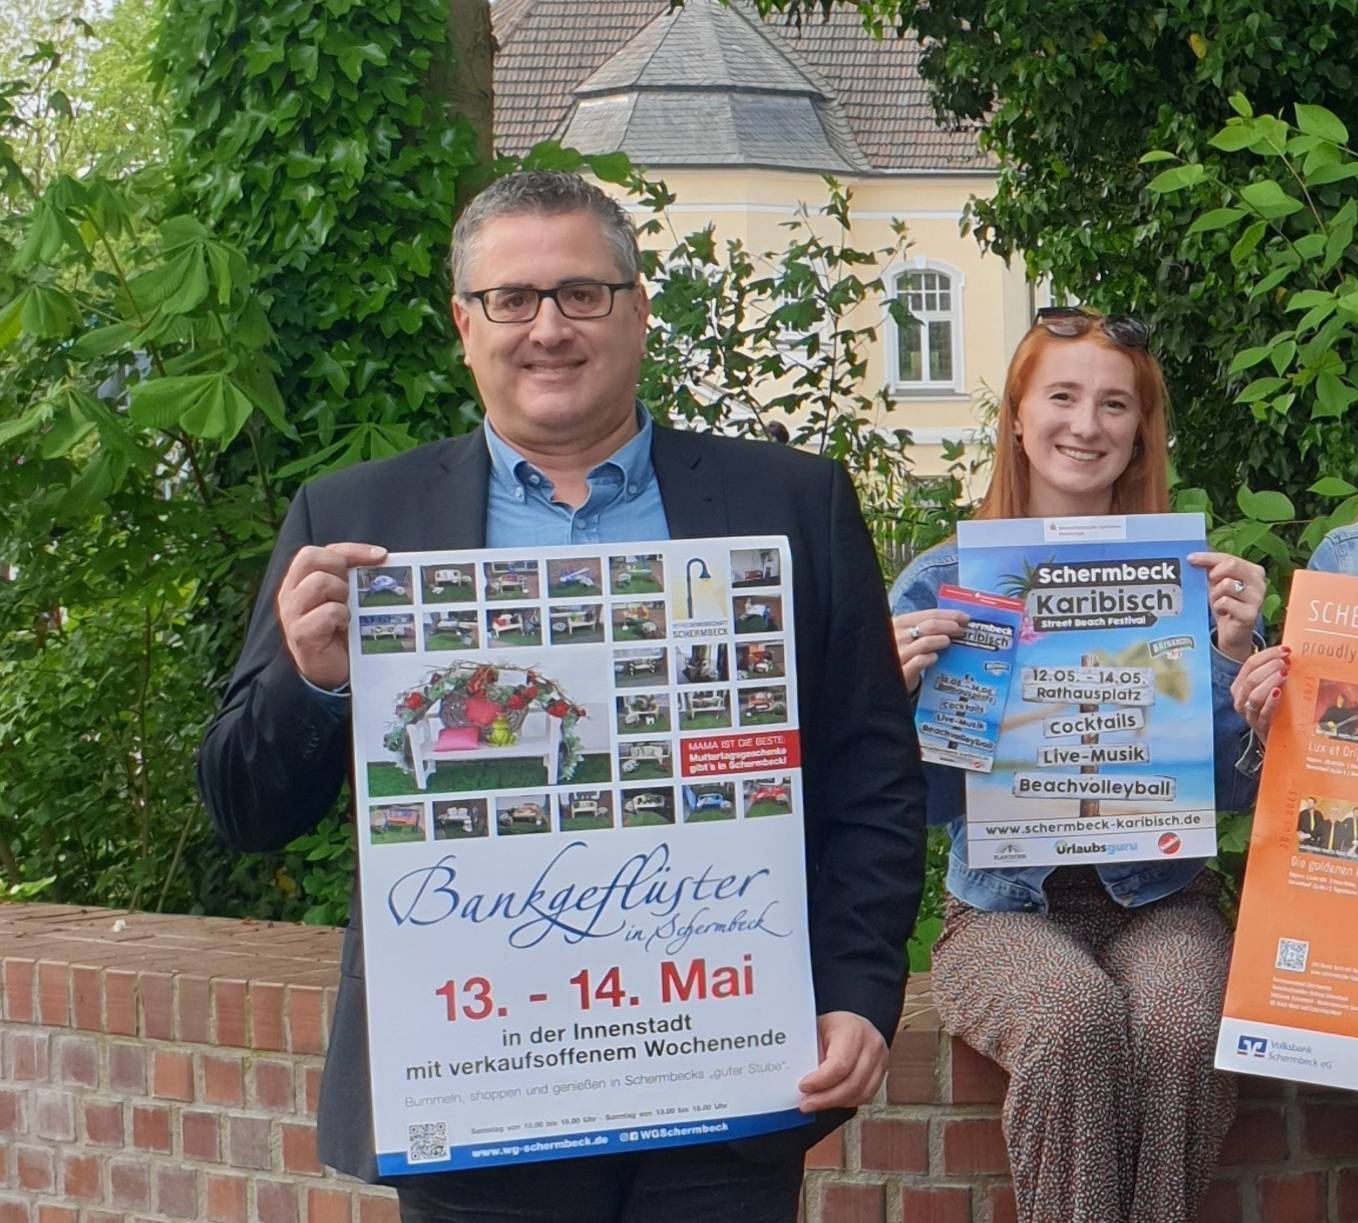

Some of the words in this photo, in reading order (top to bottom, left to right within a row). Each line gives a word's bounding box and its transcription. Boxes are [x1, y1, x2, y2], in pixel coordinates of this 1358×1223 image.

[1038, 562, 1176, 584] Schermbeck
[1037, 588, 1174, 615] Karibisch
[1041, 618, 1072, 628] Street
[1075, 617, 1105, 627] Beach
[1108, 615, 1146, 626] Festival
[673, 628, 728, 639] SCHERMBECK
[1301, 641, 1357, 664] proudly
[1033, 669, 1080, 683] 12.05.
[1099, 671, 1146, 685] 14.05.
[1037, 687, 1141, 702] Rathausplatz
[1050, 712, 1137, 735] Cocktails
[688, 740, 718, 750] MAMA
[721, 739, 735, 748] IST
[738, 737, 753, 747] DIE
[1308, 742, 1327, 753] Lux
[1043, 745, 1145, 764] Live-Musik
[1020, 778, 1170, 799] Beachvolleyball
[985, 814, 1201, 835] www.schermbeck-karibisch.de
[1290, 855, 1306, 869] Die
[388, 841, 770, 948] Bankgeflüster
[624, 922, 645, 942] in
[645, 901, 793, 955] Schermbeck
[435, 976, 508, 1021] 13.
[529, 992, 547, 1003] -
[569, 966, 640, 1011] 14.
[661, 954, 754, 1003] Mai
[502, 1028, 521, 1047] in
[530, 1024, 566, 1046] der
[573, 1014, 692, 1041] Innenstadt
[405, 1060, 443, 1081] mit
[449, 1043, 637, 1077] verkaufsoffenem
[644, 1029, 787, 1059] Wochenende
[1270, 1040, 1312, 1053] Volksbank
[1267, 1051, 1318, 1067] Schermbeck
[404, 1093, 465, 1109] Bummeln,
[470, 1086, 522, 1103] shoppen
[526, 1084, 549, 1097] und
[552, 1078, 606, 1096] genießen
[610, 1076, 621, 1087] in
[625, 1069, 705, 1087] Schermbecks
[472, 1134, 609, 1159] www.wg-schermbeck.de
